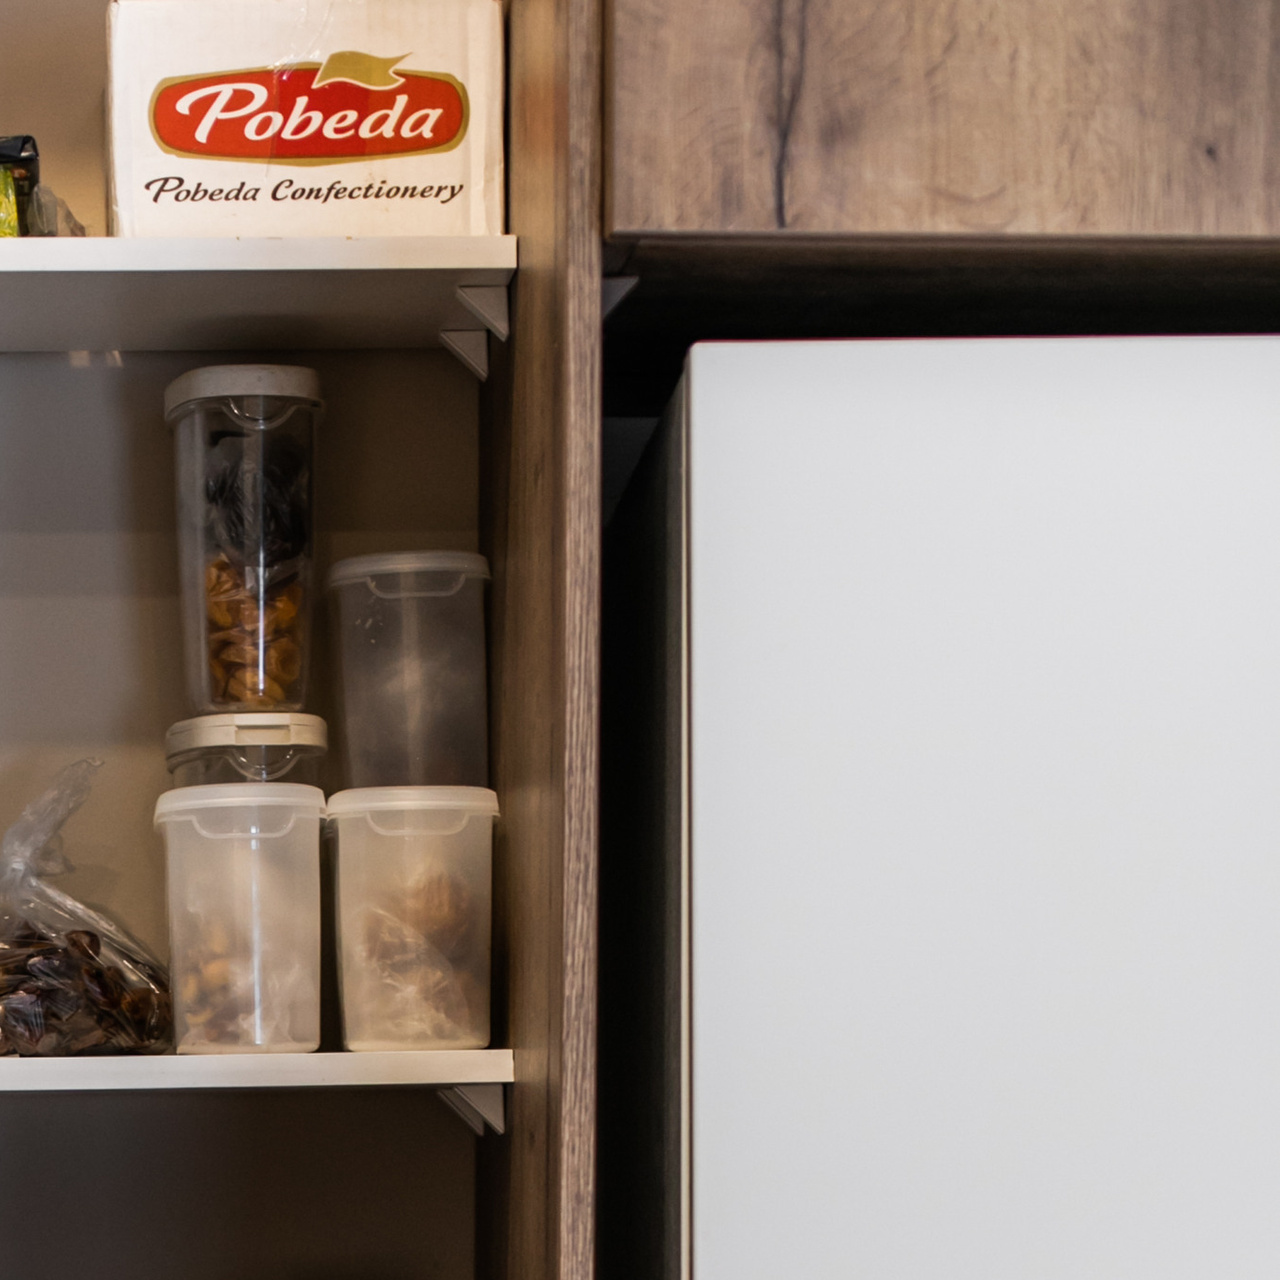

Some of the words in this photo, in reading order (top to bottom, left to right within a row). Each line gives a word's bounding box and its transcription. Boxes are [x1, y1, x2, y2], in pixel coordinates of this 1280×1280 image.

[175, 82, 443, 144] Pobeda
[144, 176, 260, 204] Pobeda
[271, 179, 464, 204] Confectionery
